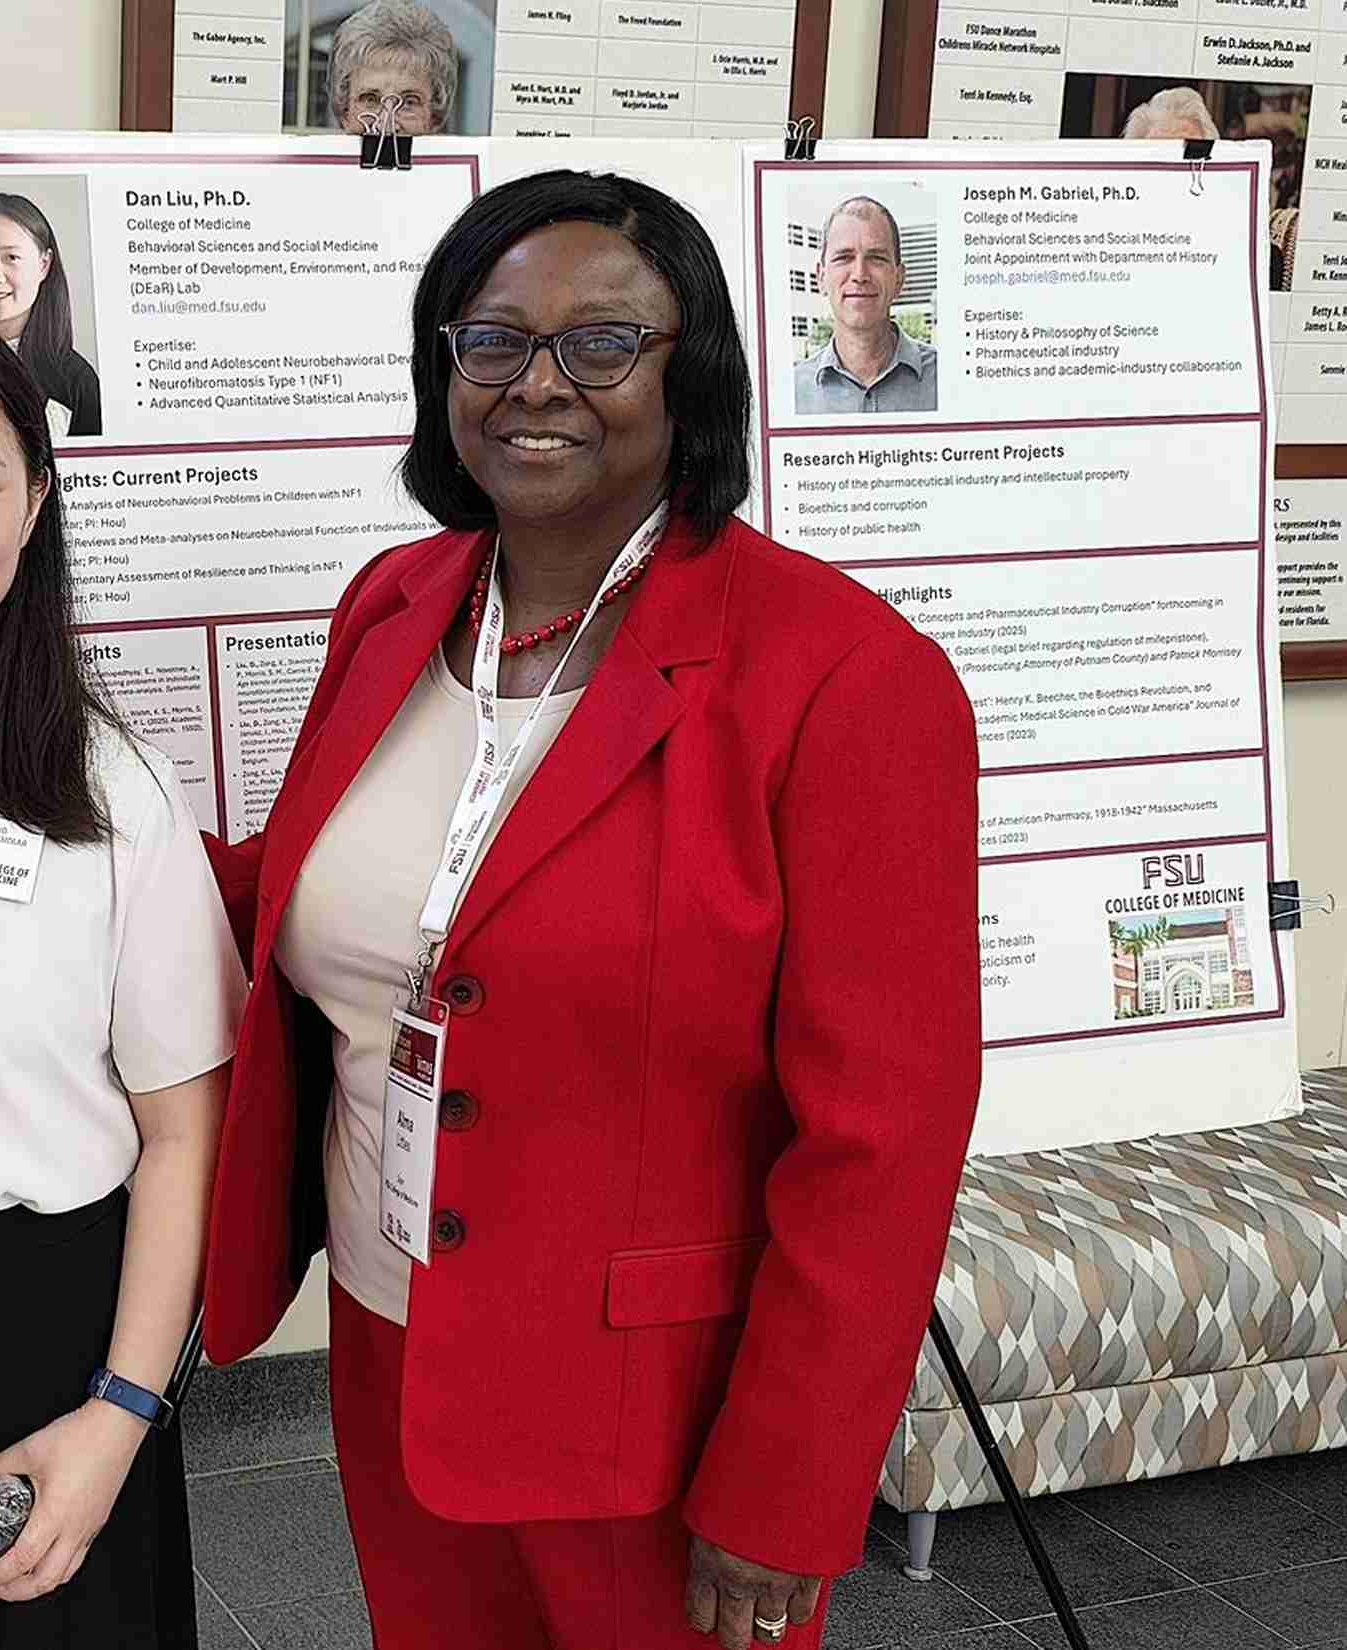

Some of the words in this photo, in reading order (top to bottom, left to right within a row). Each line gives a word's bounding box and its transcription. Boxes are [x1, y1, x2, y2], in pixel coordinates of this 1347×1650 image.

[125, 190, 162, 206] Dan
[166, 190, 198, 208] Liu,
[203, 190, 250, 206] Ph.D.
[963, 186, 1016, 202] Joseph
[1019, 186, 1037, 200] M.
[1040, 186, 1099, 201] Gabriel,
[1102, 186, 1140, 200] Ph.D.
[126, 218, 175, 232] College
[178, 217, 191, 230] of
[193, 218, 251, 230] Medicine
[963, 211, 1009, 226] College
[1010, 211, 1023, 223] of
[1025, 211, 1078, 223] Medicine
[128, 240, 195, 253] Behavioral
[197, 240, 255, 253] Sciences
[257, 240, 281, 252] and
[282, 239, 320, 252] Social
[322, 240, 378, 252] Medicine
[964, 233, 1026, 246] Behavioral
[1028, 232, 1081, 245] Sciences
[1083, 233, 1105, 245] and
[1106, 232, 1141, 244] Social
[1142, 233, 1191, 244] Medicine
[964, 253, 992, 265] Joint
[993, 252, 1070, 265] Appointment
[1071, 251, 1097, 263] with
[1099, 251, 1164, 263] Department
[1165, 251, 1177, 263] of
[1178, 251, 1218, 265] History
[129, 263, 182, 275] Member
[185, 262, 198, 274] of
[200, 262, 287, 275] Development,
[289, 262, 370, 274] Environment,
[373, 262, 396, 273] and
[963, 270, 1131, 286] joseph.gabriel@med.fsu.edu
[130, 281, 174, 296] (DEaR)
[176, 281, 201, 294] Lab
[131, 300, 266, 314] dan.liu@med.fsu.edu
[964, 309, 1023, 322] Expertise:
[975, 328, 1019, 342] History
[1020, 327, 1029, 339] &
[1032, 327, 1098, 340] Philosophy
[1098, 325, 1111, 337] of
[1113, 324, 1159, 337] Science
[133, 339, 196, 353] Expertise:
[975, 345, 1070, 359] Pharmaceutical
[1071, 344, 1120, 358] industry
[147, 358, 182, 371] Child
[184, 358, 208, 370] and
[210, 357, 280, 369] Adolescent
[282, 354, 385, 367] Neurobehavioral
[975, 366, 1031, 378] Bioethics
[1033, 365, 1056, 376] and
[1057, 362, 1168, 375] academic-industry
[1169, 361, 1242, 372] collaboration
[148, 377, 265, 390] Neurofibromatosis
[268, 375, 296, 389] Type
[309, 373, 342, 387] (NF1)
[149, 397, 212, 409] Advanced
[214, 394, 291, 408] Quantitative
[292, 392, 355, 405] Statistical
[357, 391, 408, 404] Analysis
[783, 451, 854, 466] Research
[858, 449, 938, 467] Highlights:
[941, 447, 999, 461] Current
[1003, 445, 1064, 461] Projects
[57, 472, 107, 492] ights:
[112, 470, 181, 486] Current
[186, 467, 258, 485] Projects
[797, 480, 836, 492] History
[838, 478, 849, 490] of
[851, 479, 869, 489] the
[870, 475, 954, 489] pharmaceutical
[955, 474, 1000, 486] industry
[1000, 473, 1021, 484] and
[1022, 470, 1083, 482] intellectual
[1084, 470, 1130, 481] property
[69, 500, 113, 512] Analysis
[114, 498, 126, 509] of
[127, 495, 212, 508] Neurobehavioral
[213, 494, 261, 504] Problems
[263, 492, 273, 501] in
[274, 491, 317, 502] Children
[318, 490, 341, 499] with
[341, 488, 361, 498] NF1
[798, 502, 849, 514] Bioethics
[850, 501, 871, 512] and
[872, 498, 928, 511] corruption
[798, 526, 838, 537] History
[839, 524, 850, 536] of
[851, 523, 885, 536] public
[887, 522, 921, 533] health
[875, 587, 952, 605] Highlights
[490, 603, 501, 630] FSU
[226, 631, 326, 651] Presentatio
[484, 741, 495, 766] FSU
[449, 848, 467, 874] FSU
[17, 867, 30, 878] OF
[1141, 854, 1205, 889] FSU
[1104, 895, 1160, 913] COLLEGE
[1162, 893, 1179, 908] OF
[1182, 887, 1244, 906] MEDICINE
